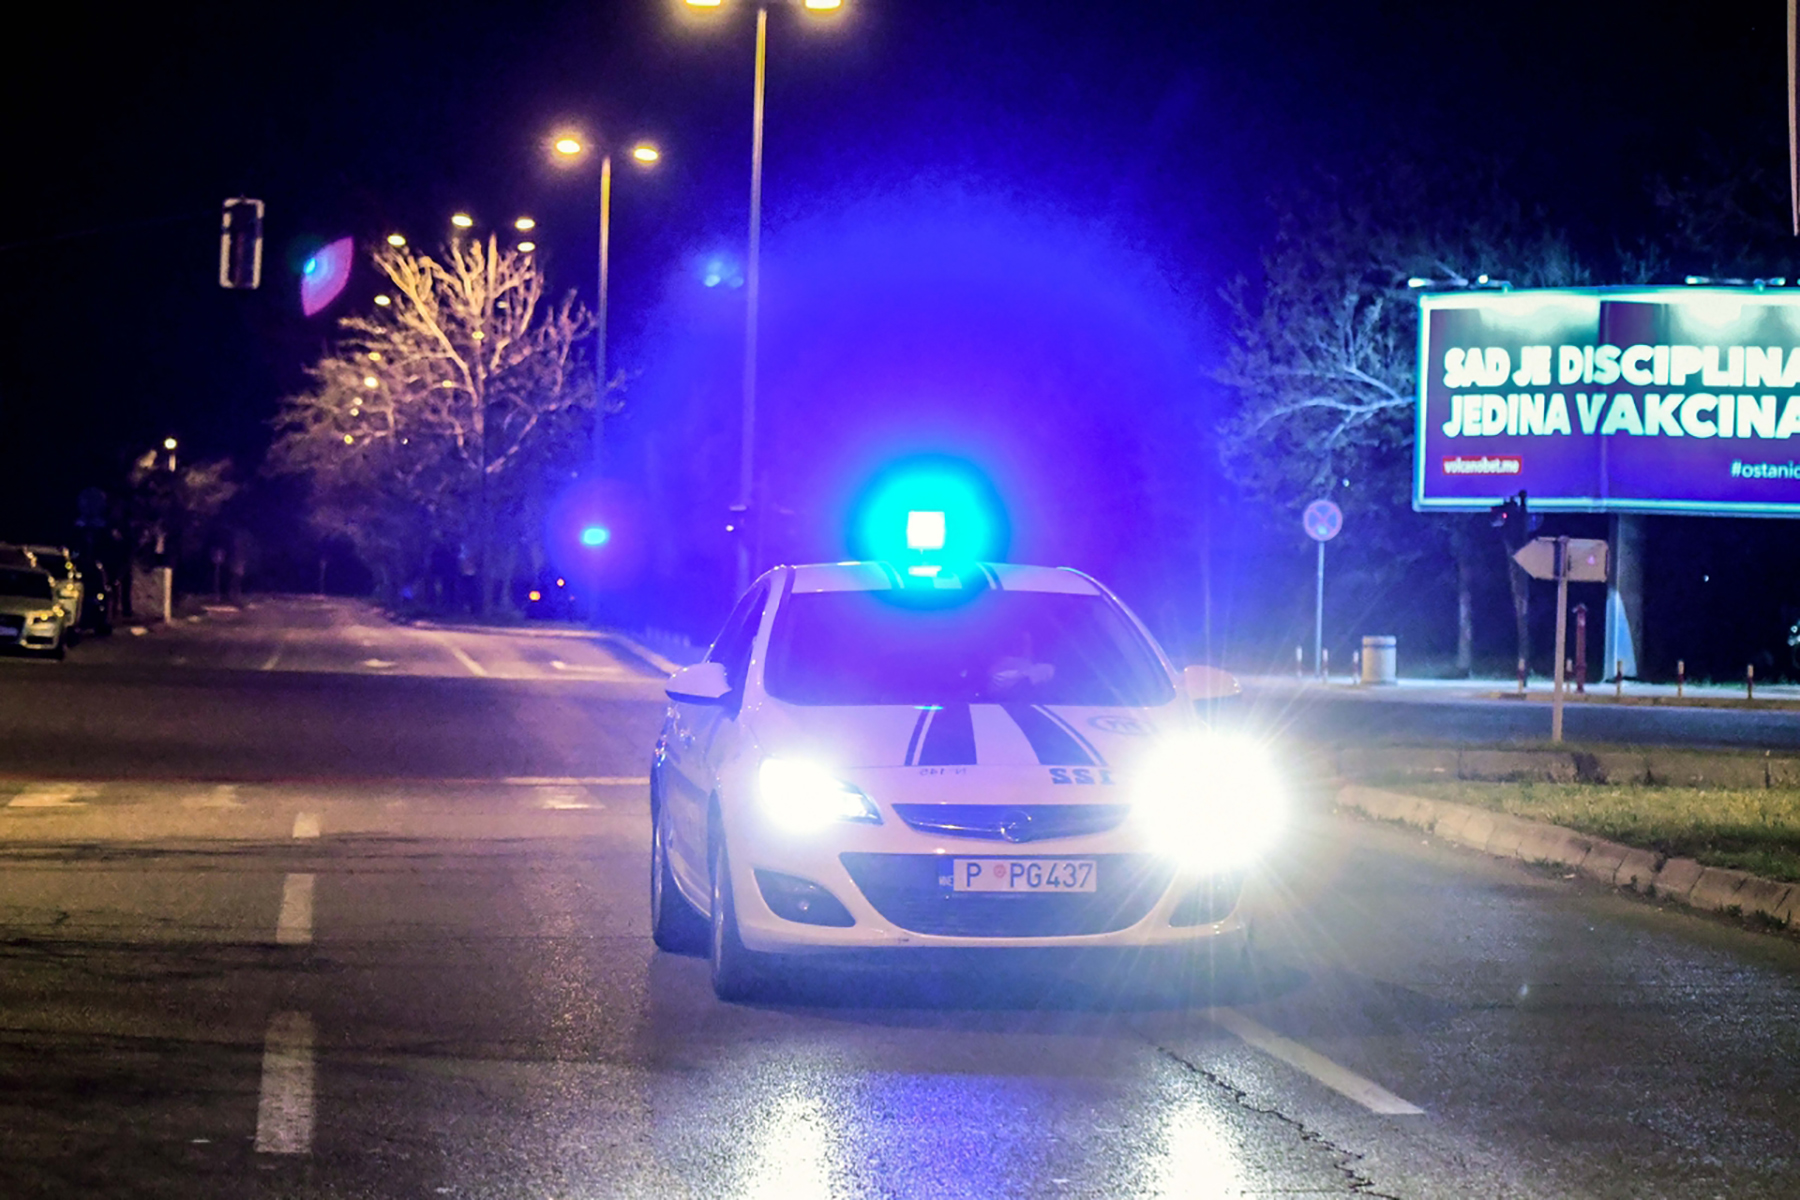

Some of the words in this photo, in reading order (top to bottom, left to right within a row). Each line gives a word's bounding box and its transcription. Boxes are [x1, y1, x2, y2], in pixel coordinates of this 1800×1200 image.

[1443, 347, 1511, 388] SAD
[1512, 345, 1551, 387] JE
[1442, 393, 1571, 438] JEDINA
[1576, 393, 1800, 439] VAKCINA
[966, 862, 982, 888] P
[1010, 862, 1094, 888] PG437
